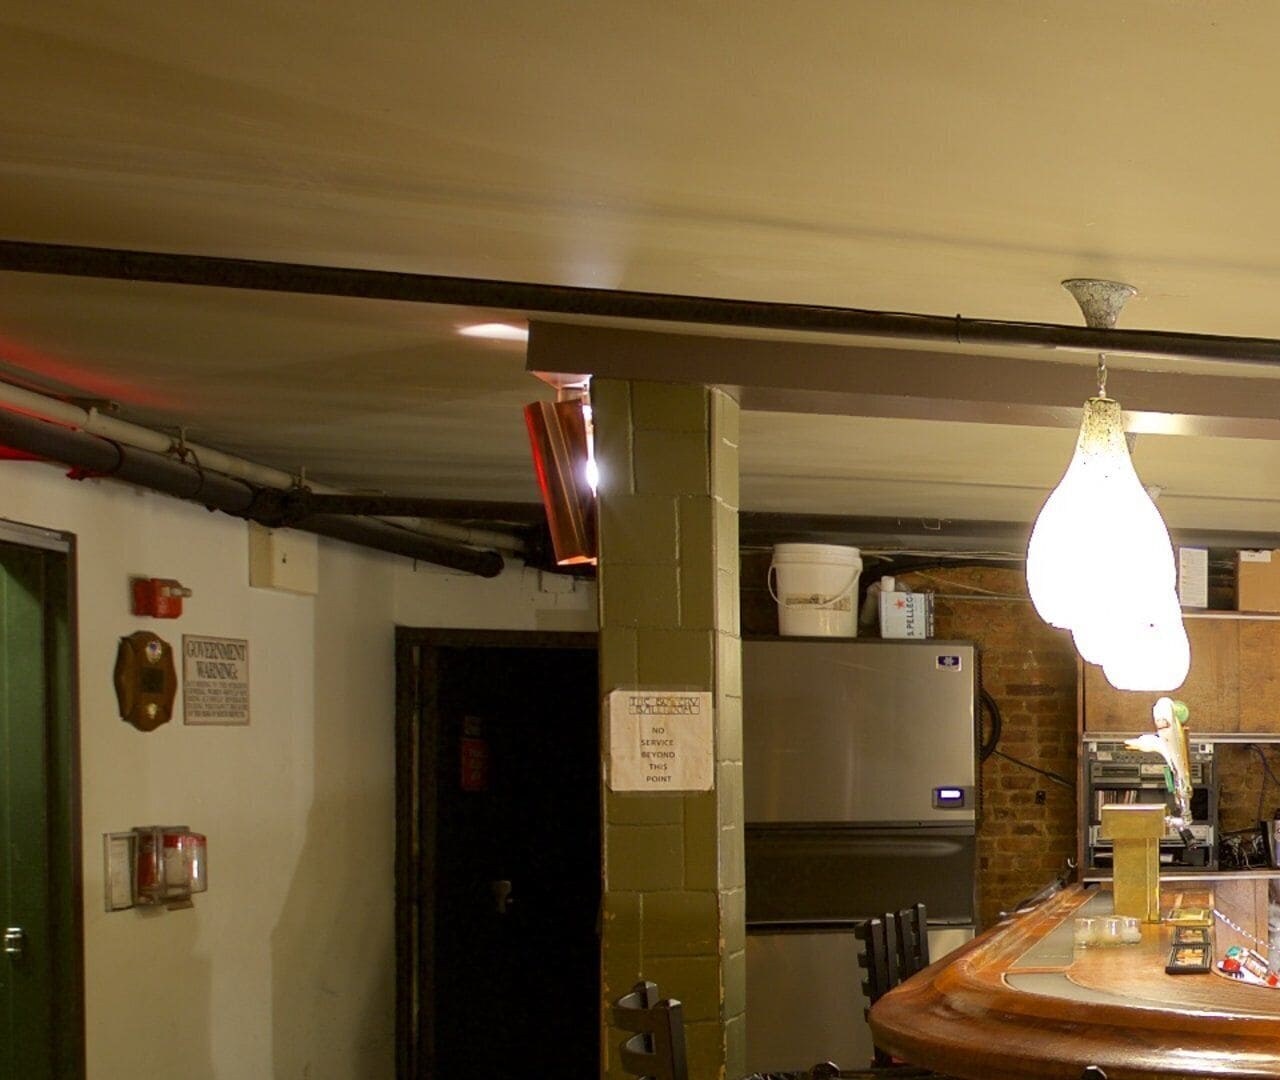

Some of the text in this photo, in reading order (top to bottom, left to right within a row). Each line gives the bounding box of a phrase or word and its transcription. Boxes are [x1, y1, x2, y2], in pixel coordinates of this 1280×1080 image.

[652, 727, 665, 735] NO
[649, 763, 668, 771] THIS
[646, 775, 672, 783] POINT
